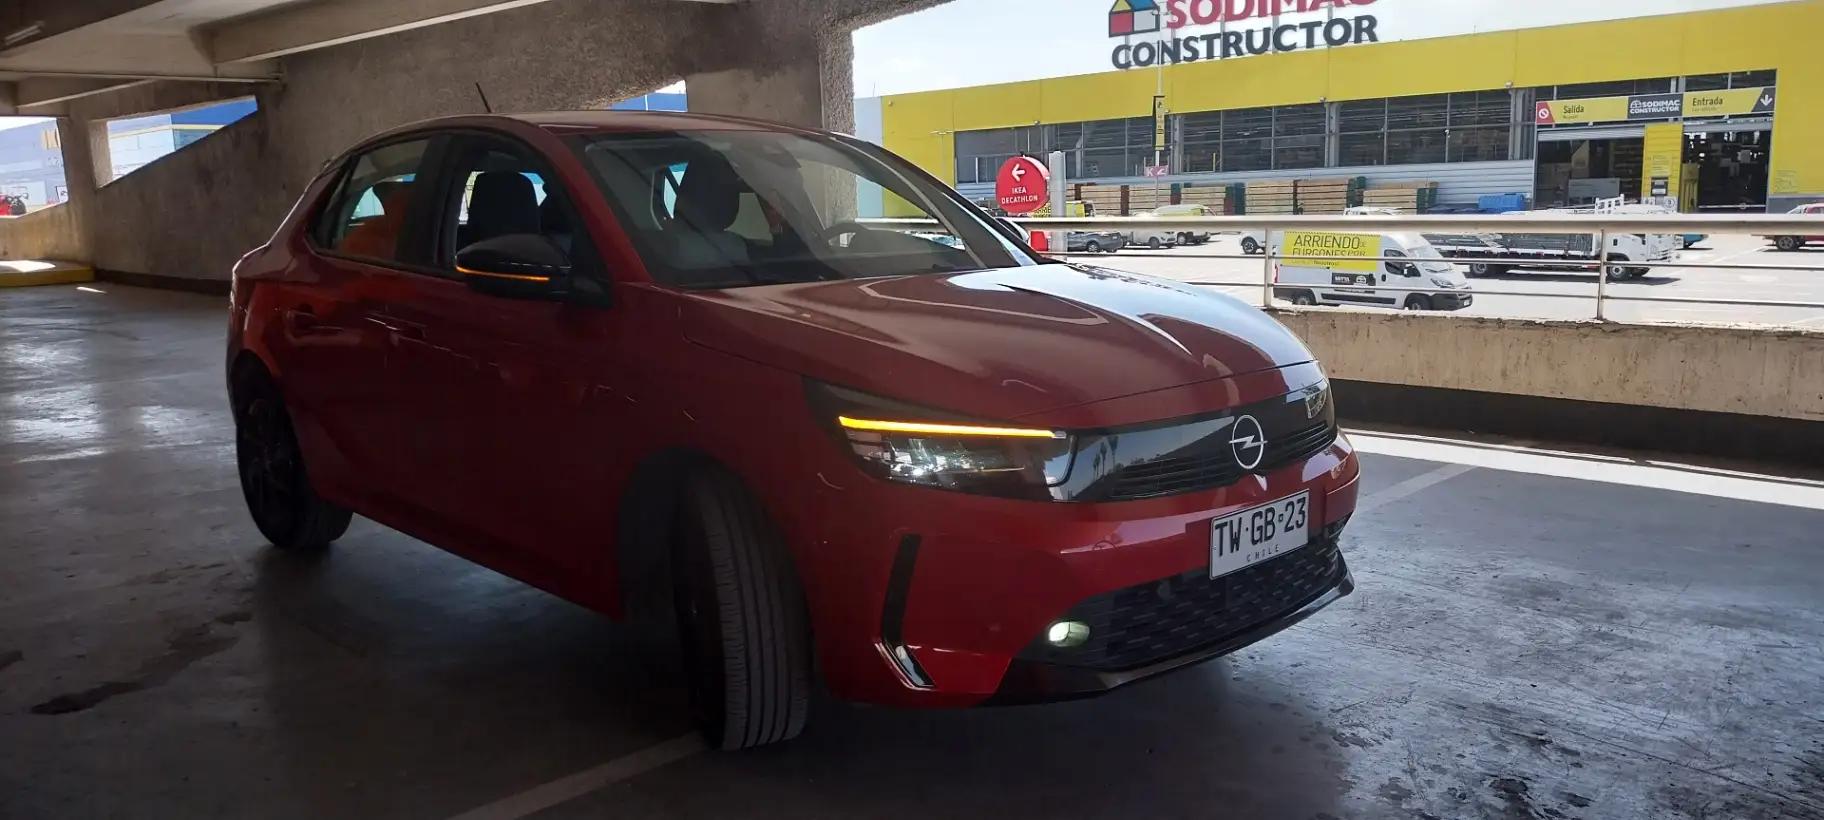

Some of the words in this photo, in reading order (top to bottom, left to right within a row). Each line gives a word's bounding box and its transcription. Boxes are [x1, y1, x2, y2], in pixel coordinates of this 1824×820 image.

[1111, 14, 1378, 69] CONSTRUCTOR
[1692, 96, 1723, 106] Entrada
[1563, 104, 1585, 114] Salida
[1001, 195, 1038, 204] DECATHLON
[1294, 234, 1360, 249] ARRIENDO
[1247, 544, 1279, 562] CHILE
